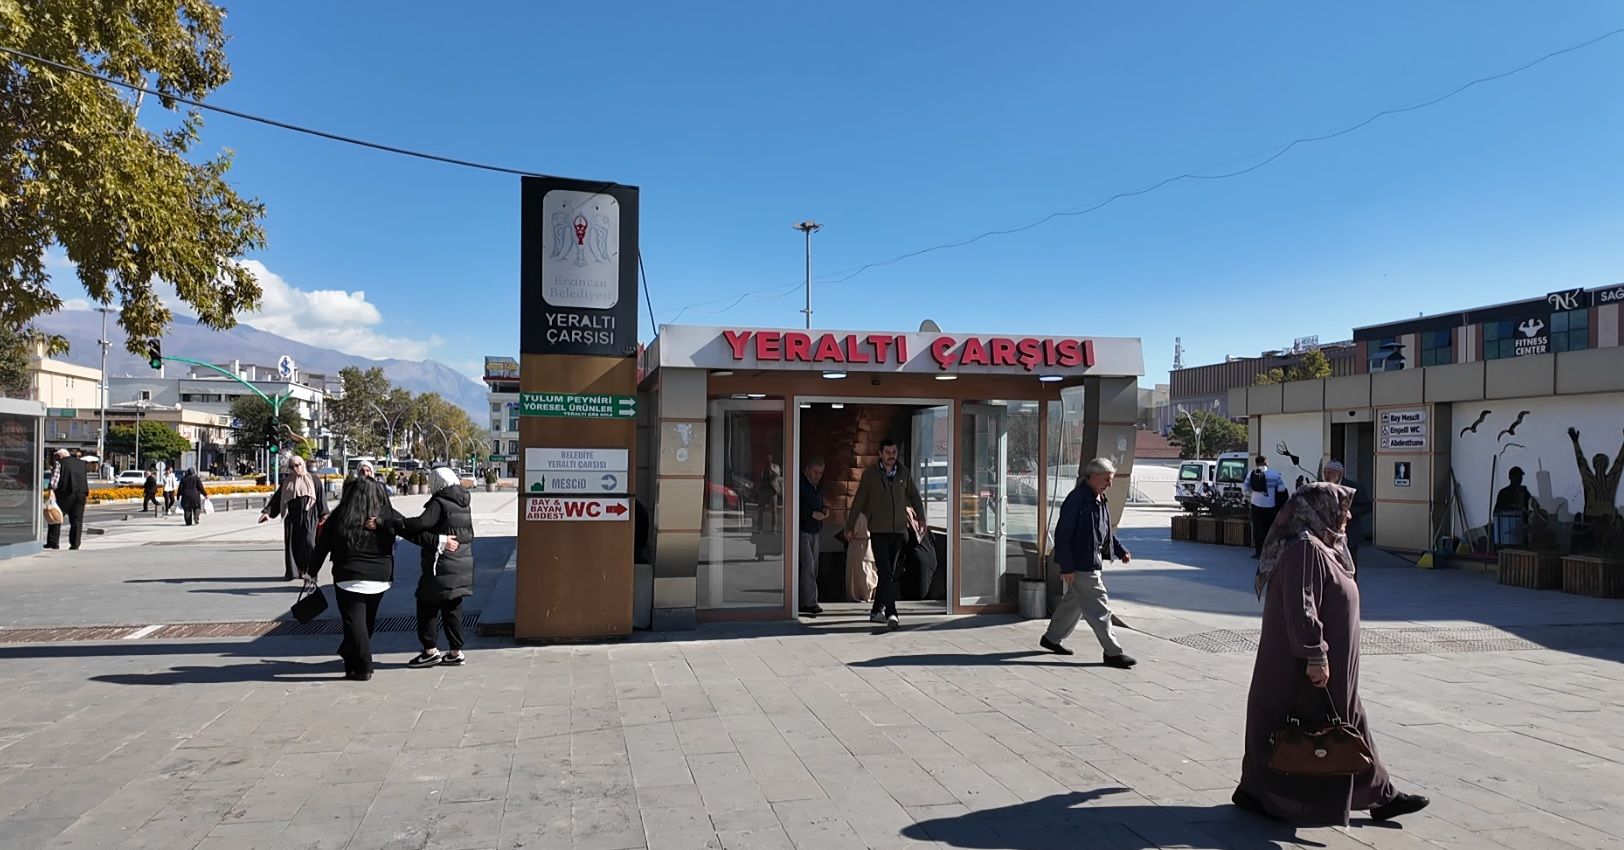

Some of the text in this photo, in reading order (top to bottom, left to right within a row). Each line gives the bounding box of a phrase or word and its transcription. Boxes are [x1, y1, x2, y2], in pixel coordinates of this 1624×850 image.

[554, 275, 607, 288] Erzincan
[550, 287, 612, 300] Belediyesi
[1548, 288, 1581, 310] NK
[545, 313, 616, 329] YERALTI
[546, 329, 614, 345] ÇARŞISI
[1515, 336, 1548, 347] FITNESS
[723, 330, 1096, 372] YERALTI ÇARŞISI
[1515, 345, 1546, 356] CENTER
[523, 394, 612, 404] TULUM PEYNİRİ
[523, 403, 613, 413] YÖRESEL ÜRÜNLER
[1390, 414, 1401, 423] Bay
[1390, 426, 1409, 434] Engelli
[1390, 439, 1424, 447] Abdesthane
[560, 450, 594, 459] BELEDİYE
[547, 460, 576, 468] YERALTI
[552, 478, 587, 489] MESCİD
[564, 501, 601, 518] WC
[527, 512, 565, 520] ABDEST
